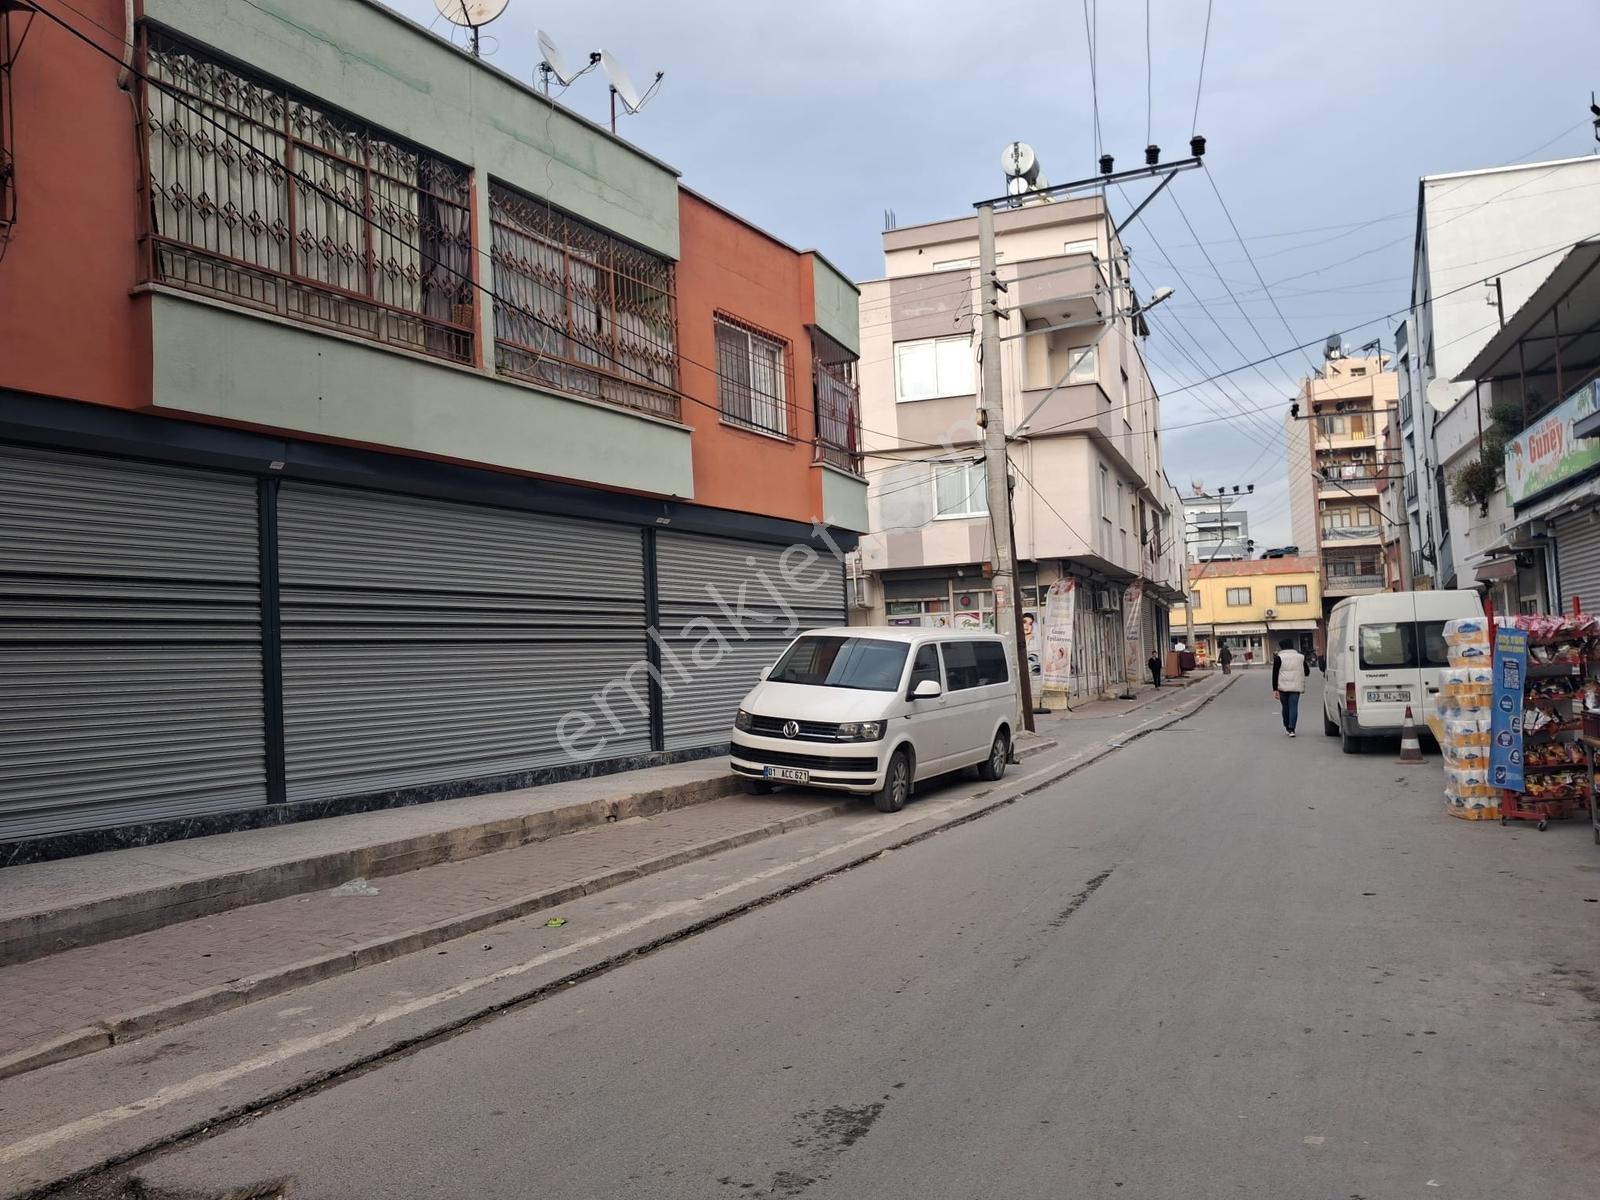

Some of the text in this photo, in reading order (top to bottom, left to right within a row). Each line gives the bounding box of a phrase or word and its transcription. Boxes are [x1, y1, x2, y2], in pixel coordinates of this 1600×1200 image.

[768, 768, 807, 780] 01 ACC 621
